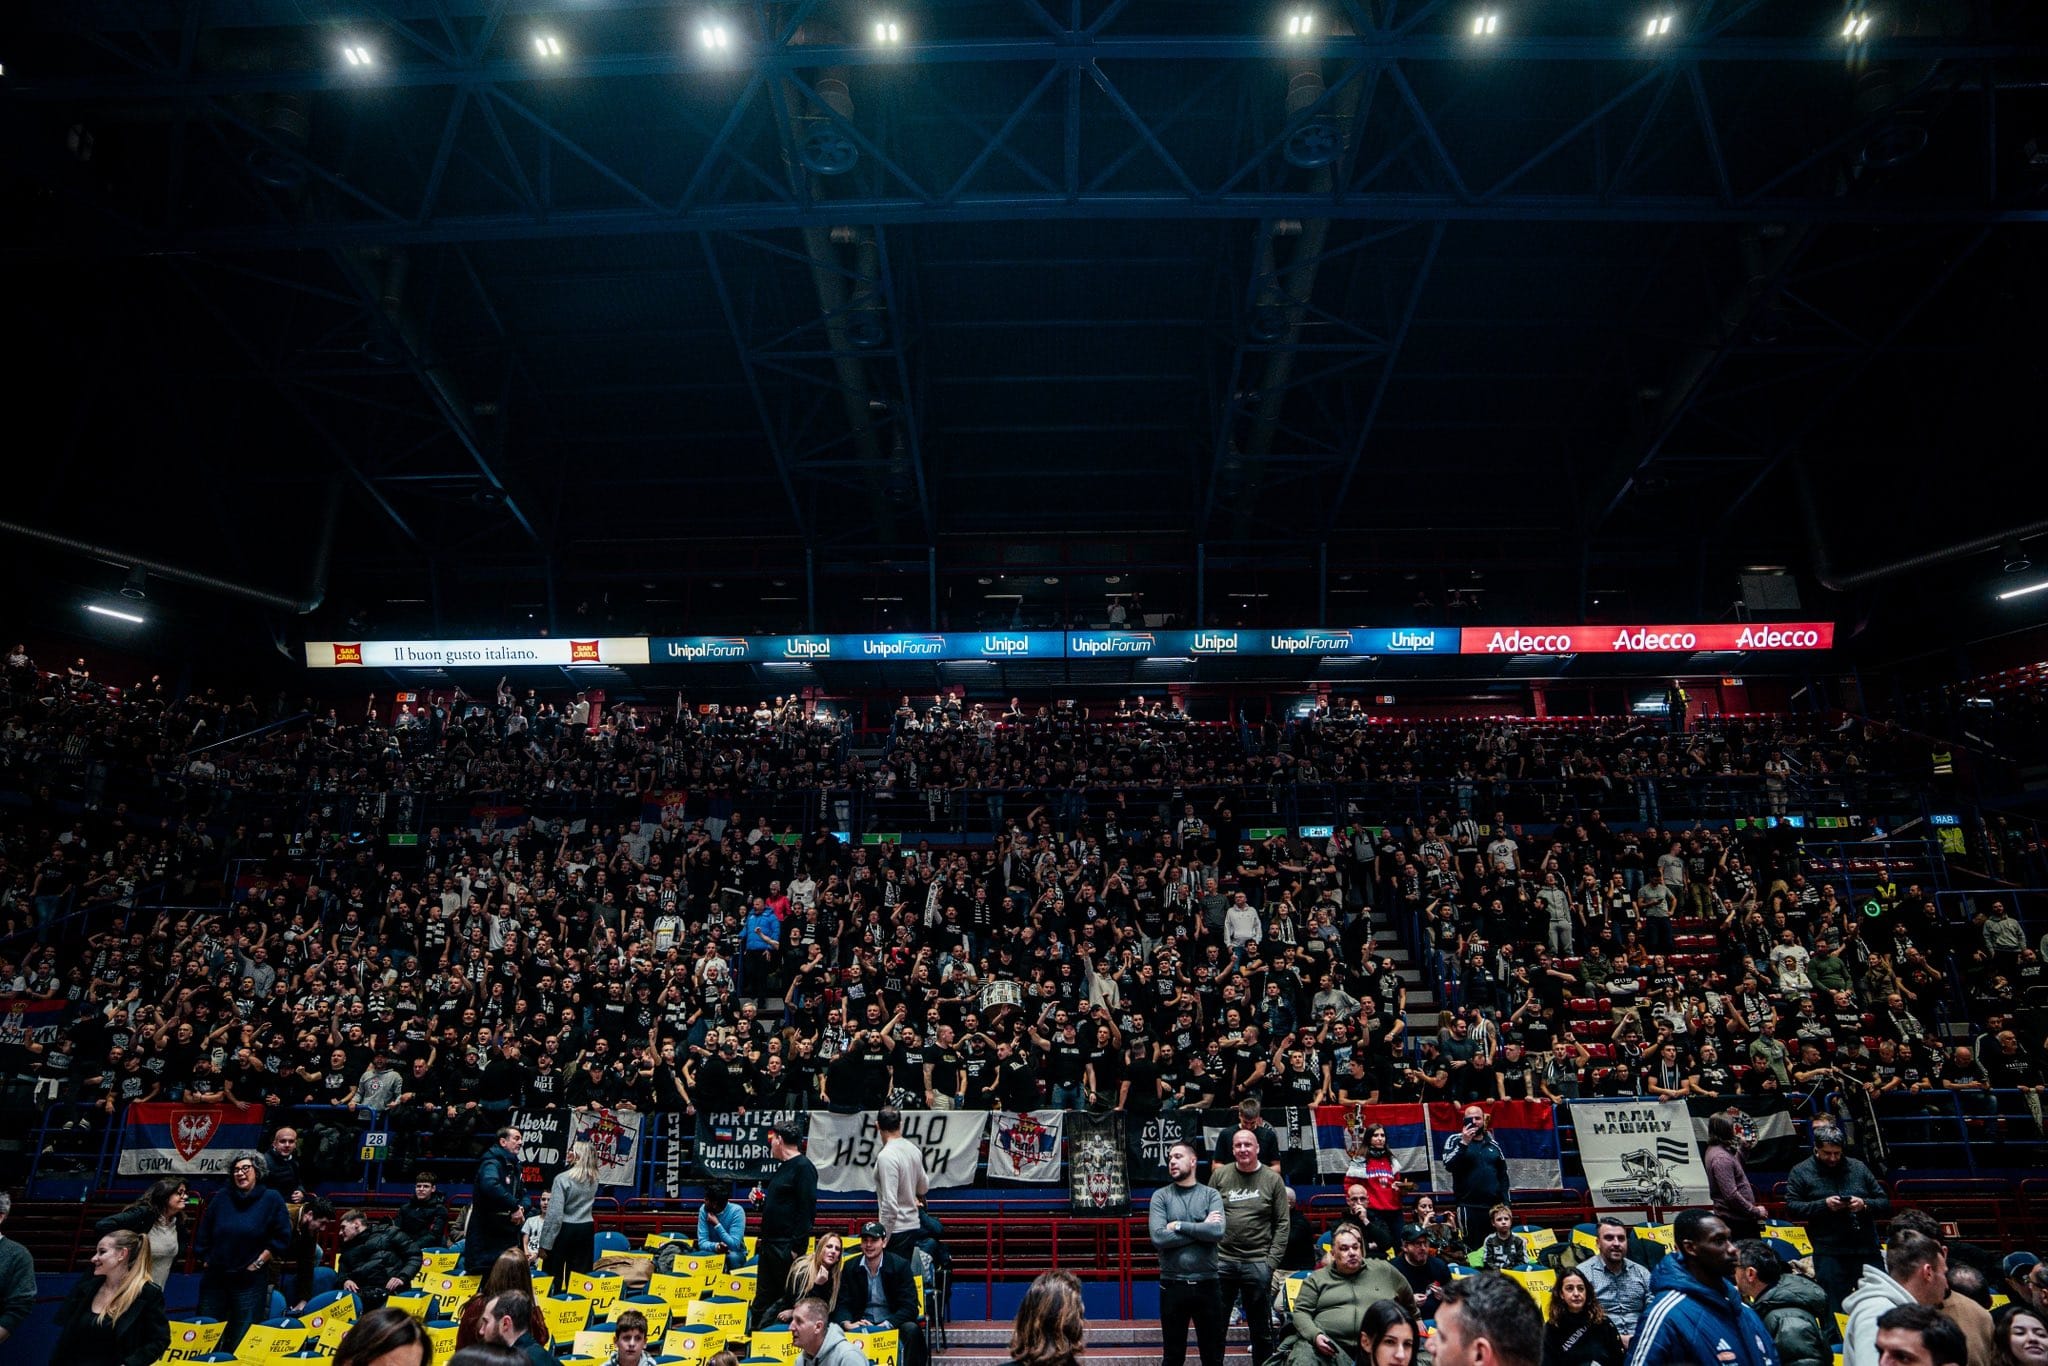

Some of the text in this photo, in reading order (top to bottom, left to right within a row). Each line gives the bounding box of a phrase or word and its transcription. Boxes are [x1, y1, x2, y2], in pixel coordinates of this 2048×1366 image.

[984, 635, 1029, 654] Unipol
[1072, 636, 1150, 654] UnipolForum
[1193, 633, 1238, 652] Unipol
[1271, 634, 1349, 651] UnipolForum
[1391, 632, 1435, 650] Unipol
[1486, 630, 1571, 652] Adecco
[1612, 628, 1696, 649] Adecco
[1736, 626, 1818, 648] Adecco
[573, 650, 597, 659] CARLO
[668, 641, 745, 660] UnipolForum
[786, 637, 831, 656] Unipol
[862, 639, 942, 656] UnipolForum
[394, 647, 538, 664] Il buon gusto italiano.
[1310, 828, 1328, 837] BAR
[709, 1110, 796, 1126] PARTIZAN
[1604, 1110, 1655, 1122] ПАЛИ
[736, 1128, 758, 1142] DE
[1593, 1121, 1671, 1134] МАШИНУ
[369, 1135, 383, 1145] 28
[522, 1129, 543, 1144] per
[704, 1159, 745, 1170] COLEGIO
[558, 1316, 584, 1324] YELLOW
[714, 1319, 742, 1327] YELLOW
